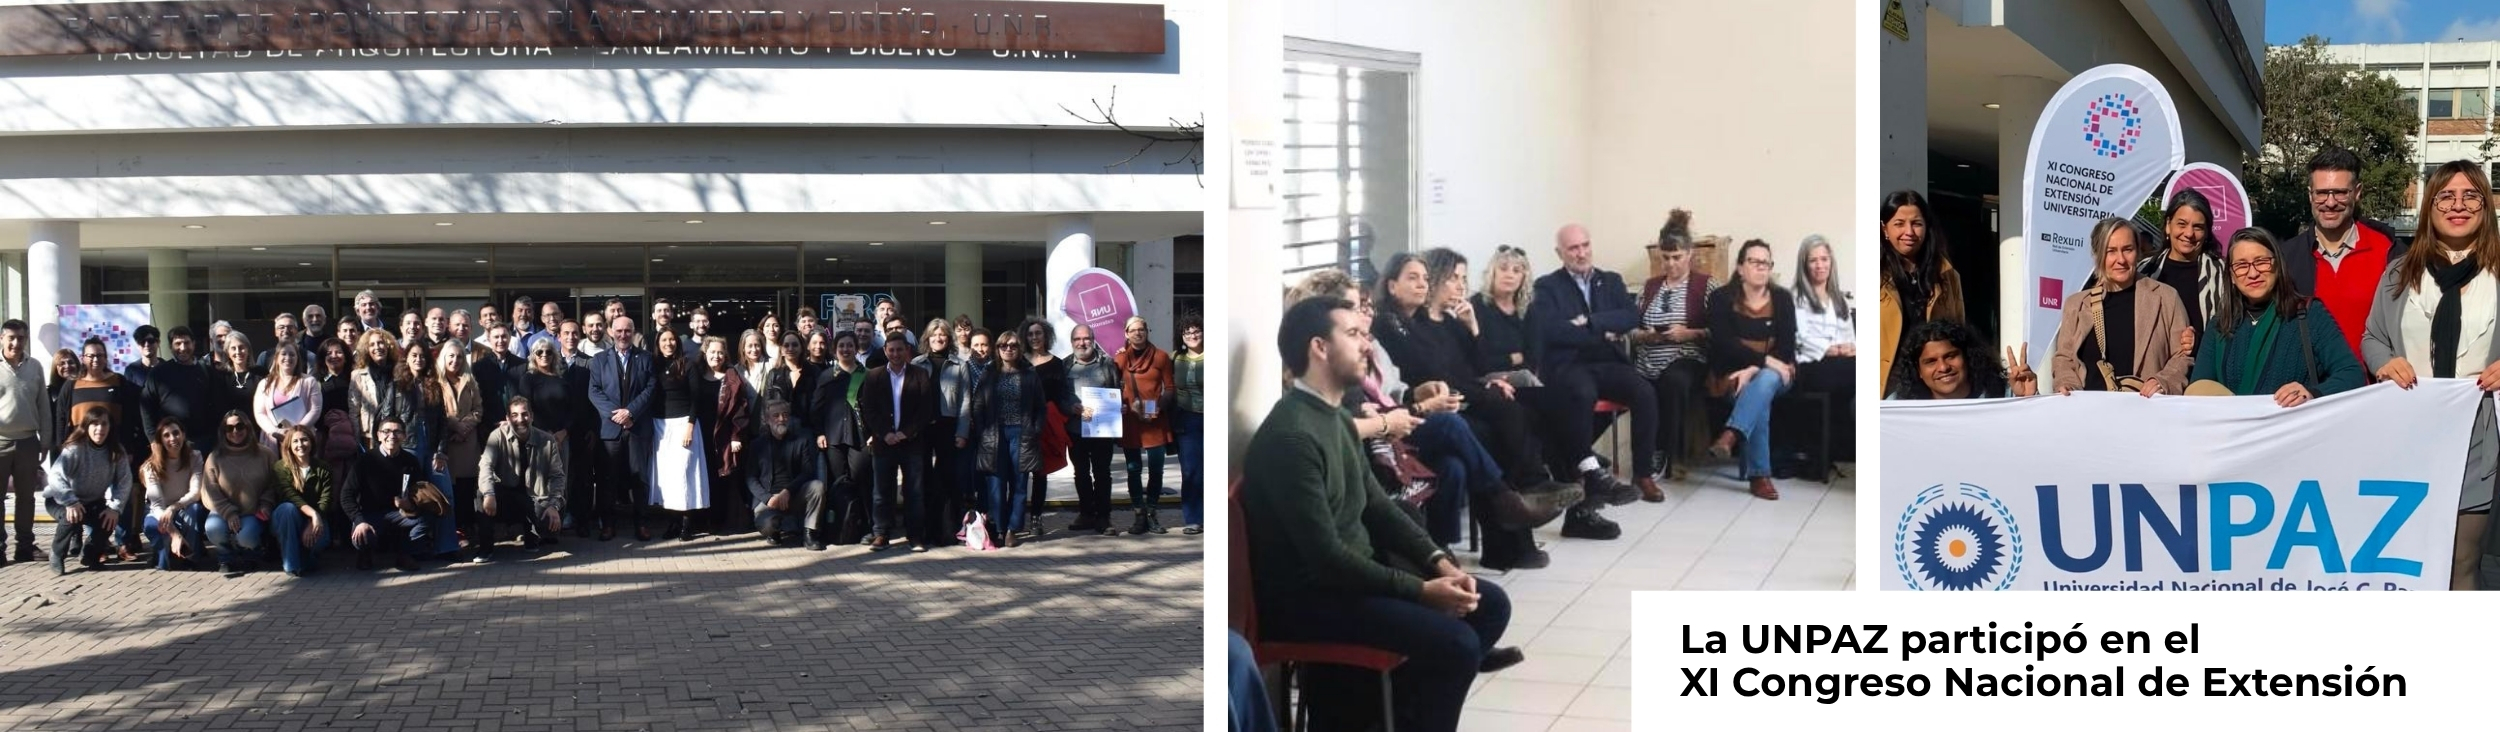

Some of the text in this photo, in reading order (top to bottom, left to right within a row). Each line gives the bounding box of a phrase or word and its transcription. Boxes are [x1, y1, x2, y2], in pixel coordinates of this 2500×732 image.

[2047, 161, 2115, 182] XI CONGRESO
[2046, 174, 2113, 195] NACIONAL DE
[2045, 187, 2100, 206] EXTENSIÓN
[2052, 233, 2084, 247] Rexuni
[2042, 297, 2058, 306] UNR
[2035, 479, 2430, 578] UNPAZ
